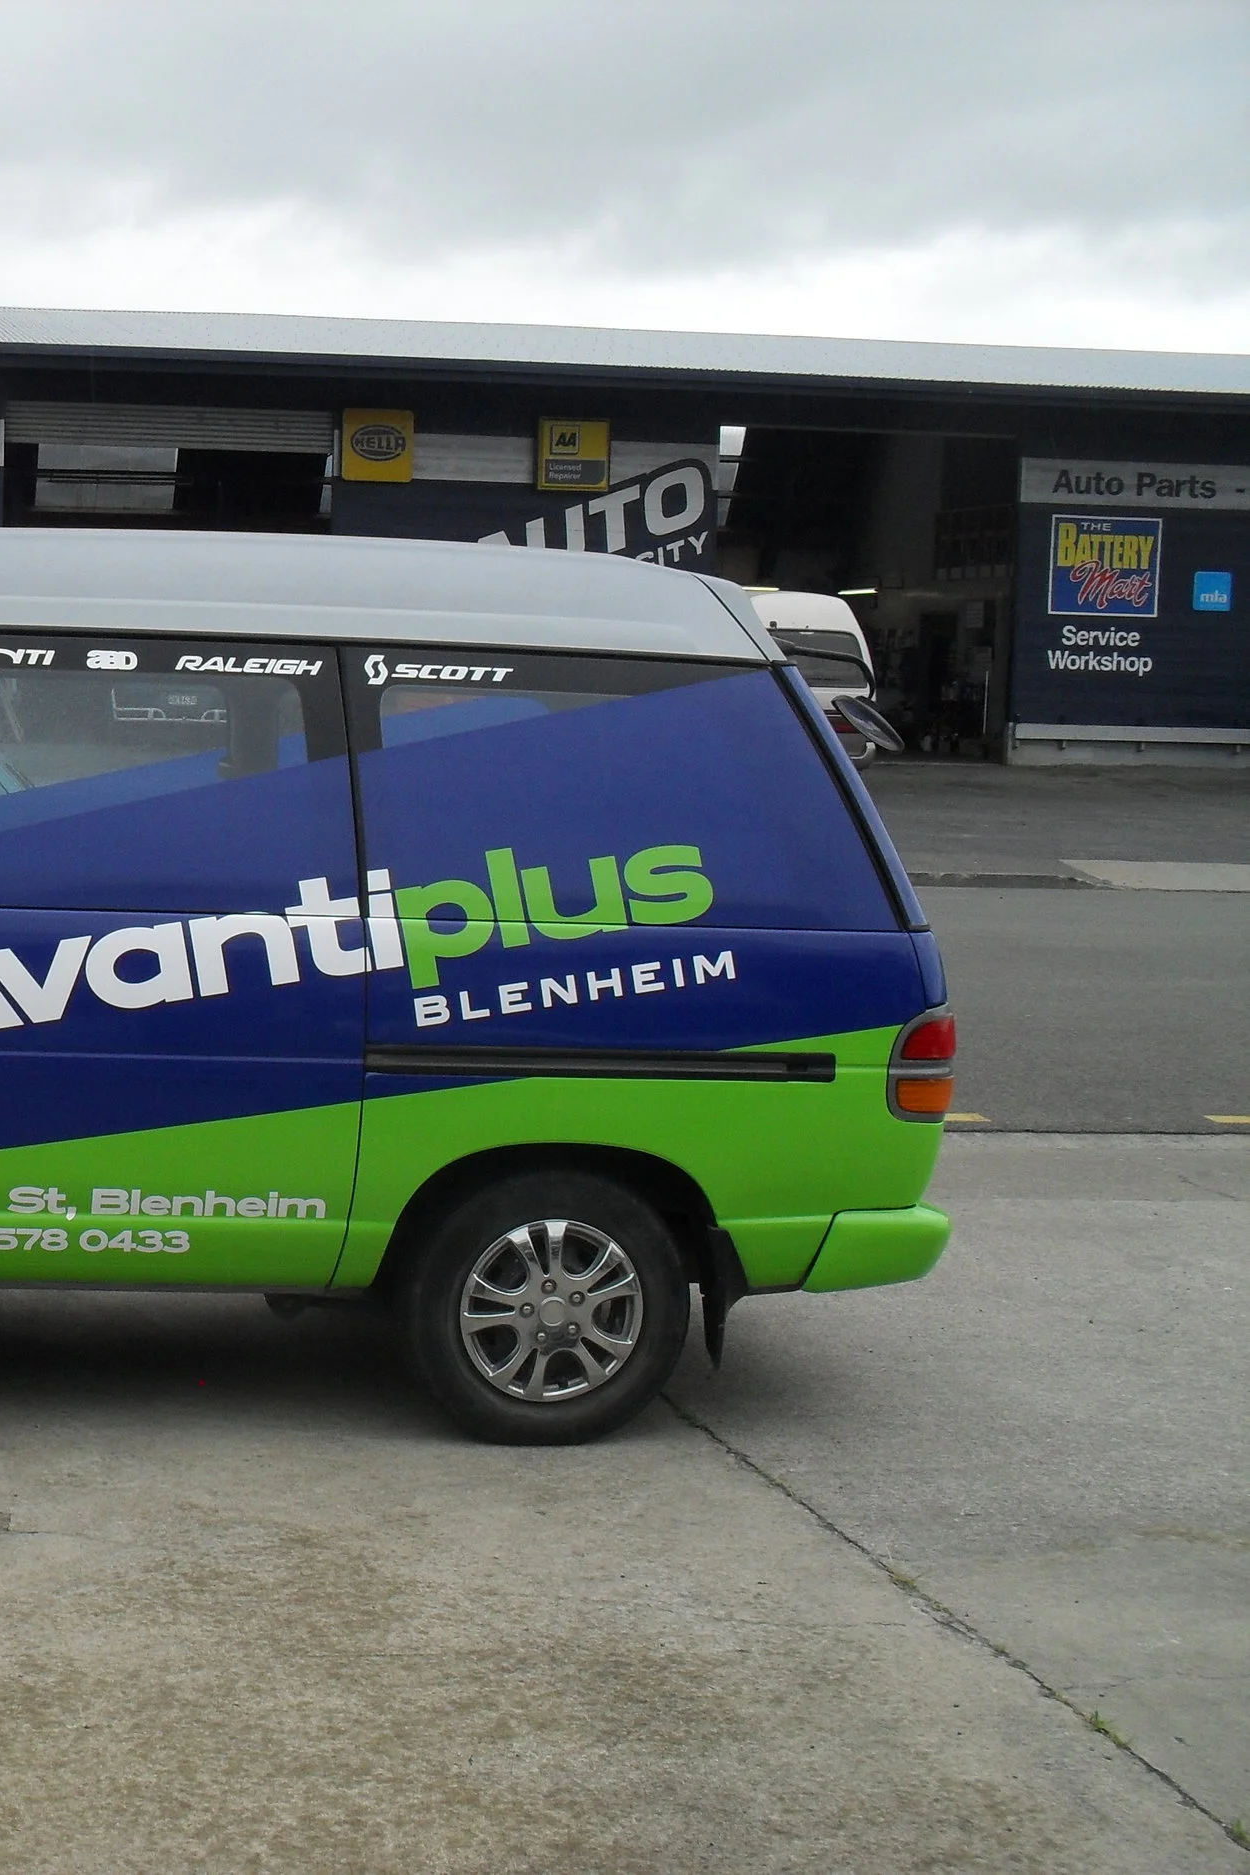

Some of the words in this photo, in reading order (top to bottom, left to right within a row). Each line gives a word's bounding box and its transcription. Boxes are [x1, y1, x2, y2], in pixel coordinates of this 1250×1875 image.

[355, 434, 406, 452] HELLA
[555, 432, 577, 447] AA
[549, 463, 582, 472] Licensed
[549, 471, 582, 481] Repairer
[1052, 469, 1124, 495] Auto
[1136, 472, 1217, 499] Parts
[477, 466, 705, 553] UTO
[1081, 522, 1112, 531] THE
[1057, 523, 1155, 569] BATTERY
[1070, 560, 1152, 609] Mart
[1061, 625, 1140, 647] Service
[175, 655, 323, 676] RALEIGH
[391, 663, 514, 682] SCOTT
[1048, 650, 1153, 677] Workshop
[414, 950, 738, 1028] BLENHEIM
[7, 1186, 77, 1221] St,
[91, 1188, 327, 1219] Blenheim
[79, 1229, 190, 1253] 0433
